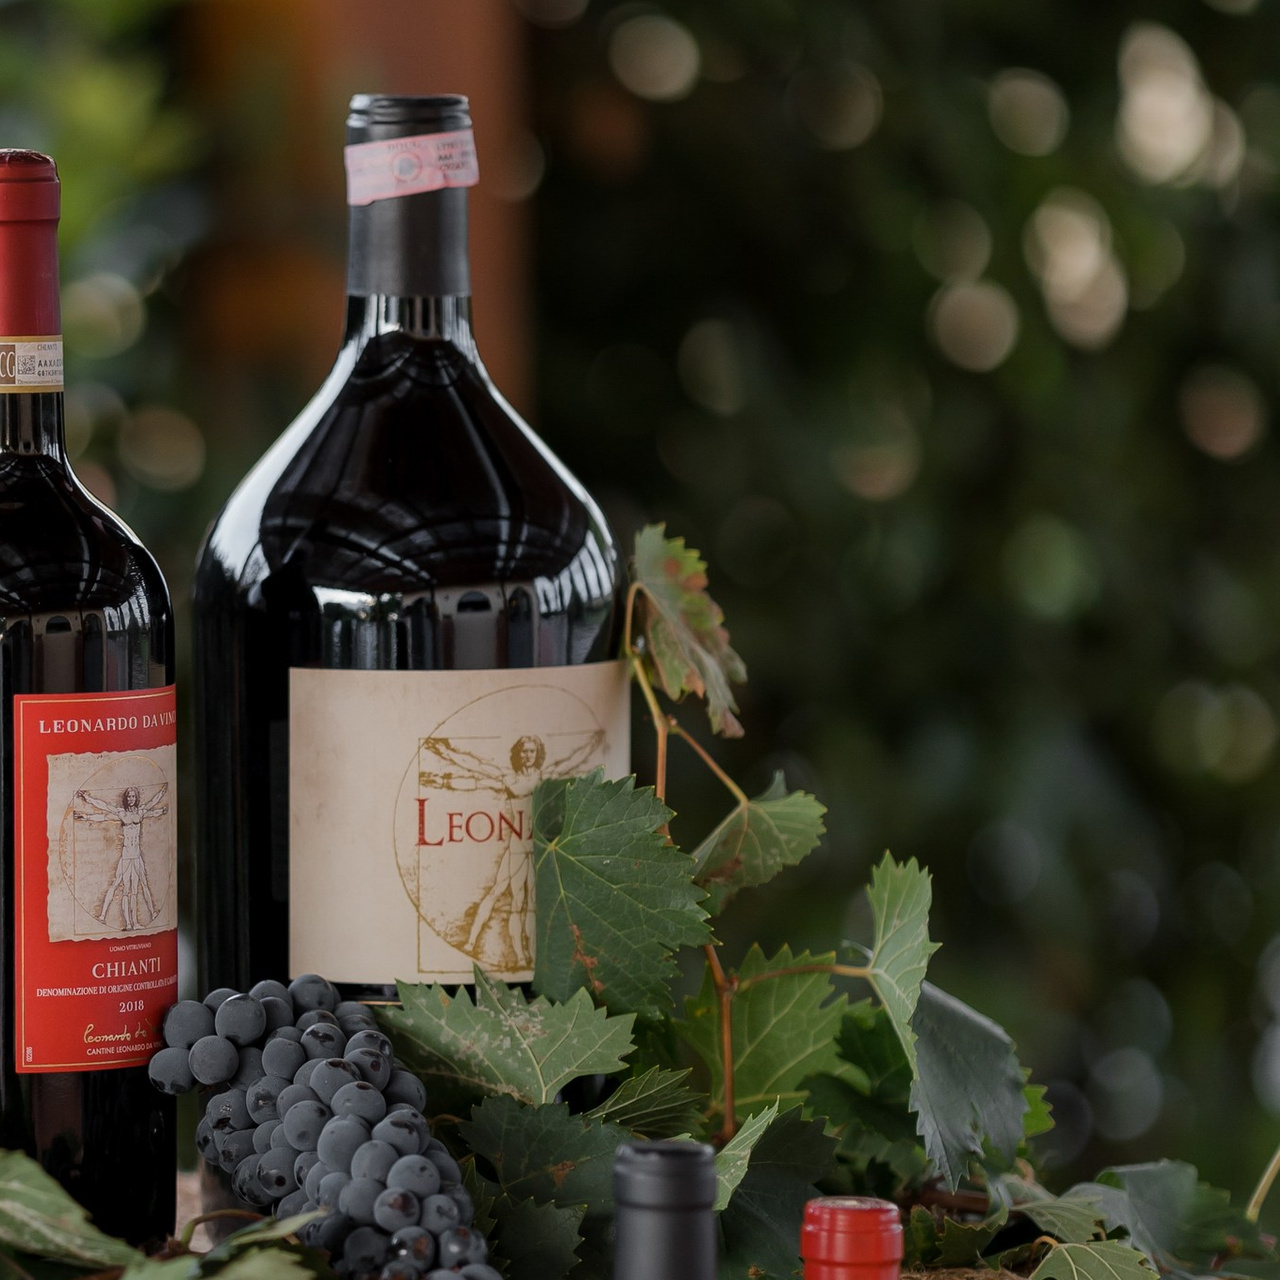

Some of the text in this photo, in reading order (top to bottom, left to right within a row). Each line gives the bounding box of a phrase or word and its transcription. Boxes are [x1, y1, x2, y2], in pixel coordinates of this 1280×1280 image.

[39, 716, 138, 734] LEONARDO
[142, 714, 158, 729] DA
[415, 797, 534, 847] LEON
[92, 957, 161, 979] CHIANTI
[36, 985, 98, 997] DENOMINAZIONE
[99, 984, 107, 994] DI
[108, 982, 133, 994] ORIGINE
[119, 1000, 145, 1013] 2018
[86, 1046, 115, 1056] CANTINE
[116, 1043, 145, 1054] LEONARDO
